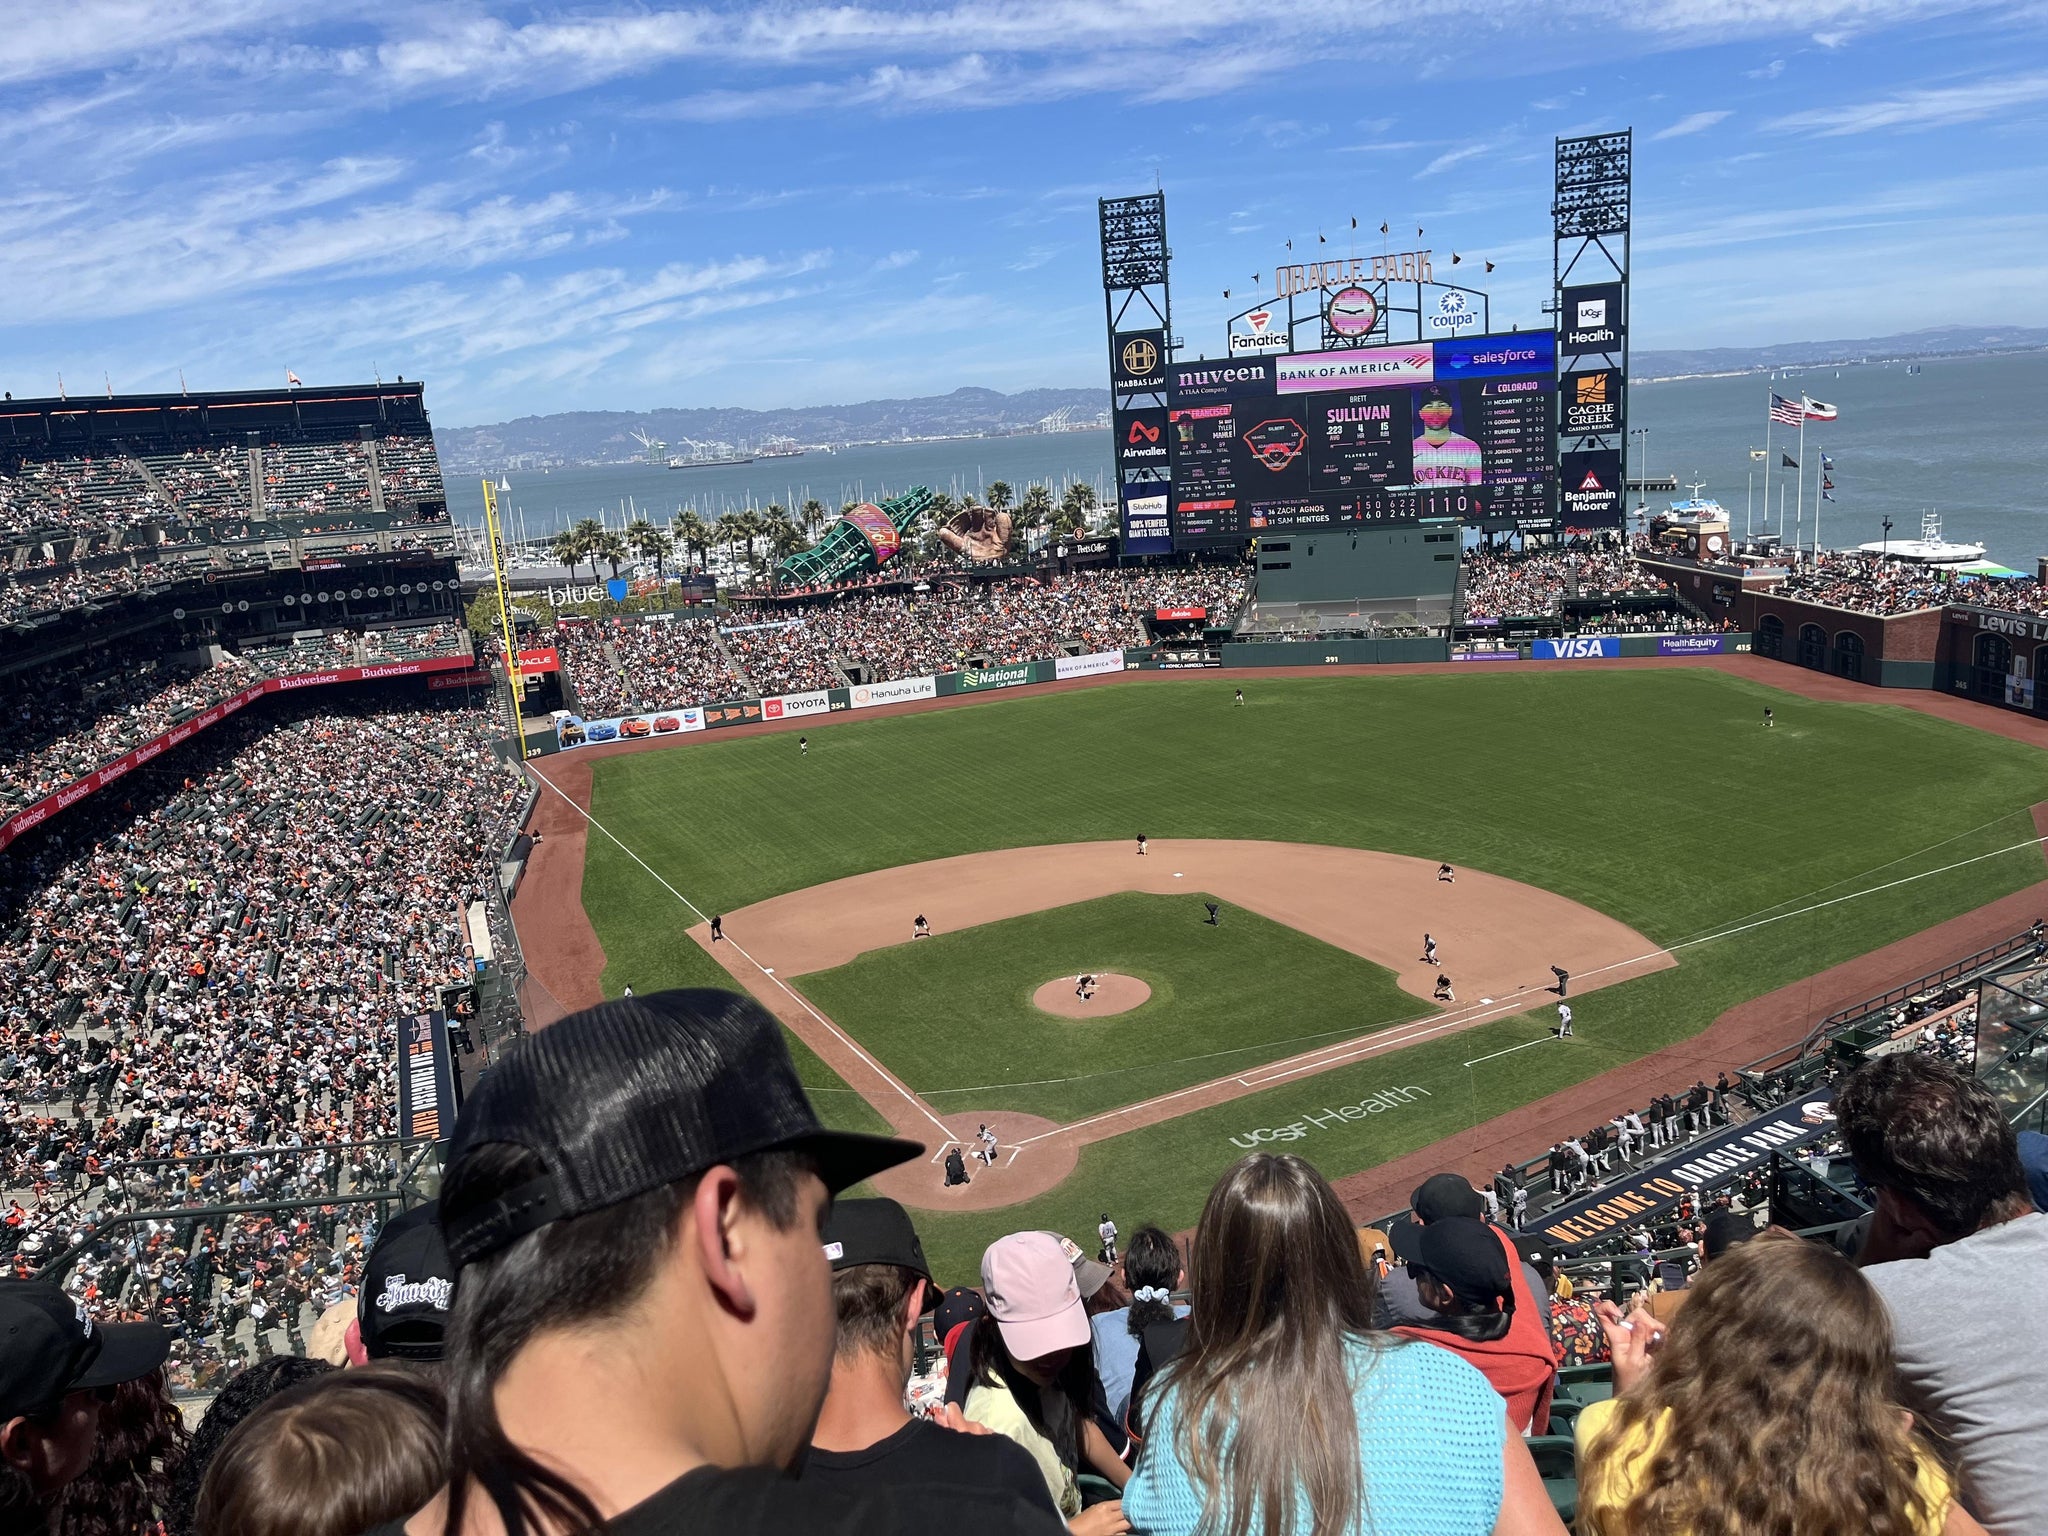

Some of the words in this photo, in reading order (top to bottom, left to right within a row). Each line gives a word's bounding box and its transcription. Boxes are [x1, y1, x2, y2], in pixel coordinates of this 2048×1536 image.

[1276, 259, 1363, 299] ORACLE
[1372, 250, 1433, 284] PARK
[1580, 308, 1603, 319] UCSF
[1433, 314, 1473, 328] coupa
[1232, 333, 1288, 349] Fanatics
[1569, 329, 1614, 344] Health
[1473, 349, 1536, 365] salesforce
[1178, 365, 1266, 387] nuveen
[1280, 369, 1315, 381] BANK
[1319, 367, 1335, 377] OF
[1339, 362, 1400, 375] AMERICA
[1118, 378, 1147, 388] HABBAS
[1148, 377, 1164, 386] LAW
[1497, 381, 1538, 392] COLORADO
[1201, 386, 1228, 394] Company
[1349, 395, 1367, 403] BRETT
[1327, 405, 1390, 423] SULLIVAN
[1567, 404, 1615, 416] CACHE
[1569, 414, 1613, 425] CREEK
[1326, 426, 1343, 435] .223
[1357, 424, 1364, 433] 4
[1380, 422, 1389, 431] 15
[1123, 446, 1167, 458] Airwallex
[1496, 476, 1527, 484] SULLIVAN
[1565, 489, 1616, 503] Benjamin
[1132, 501, 1162, 511] StubHub
[1277, 507, 1296, 515] ZACH
[1299, 505, 1325, 513] AGNOS
[1366, 501, 1371, 509] 5
[1375, 501, 1381, 509] 0
[1390, 500, 1395, 508] 6
[1410, 499, 1415, 507] 2
[1429, 498, 1435, 513] 1
[1444, 497, 1450, 513] 1
[1457, 496, 1467, 511] 0
[1572, 502, 1609, 512] Moore
[1296, 515, 1329, 523] HENTGES
[1366, 511, 1371, 519] 6
[1375, 510, 1381, 518] 0
[1390, 510, 1396, 518] 2
[1400, 509, 1405, 517] 4
[1410, 508, 1416, 516] 2
[1130, 520, 1144, 529] 100%
[1144, 519, 1168, 528] VERIFIED
[1128, 529, 1148, 538] GIANTS
[1148, 528, 1169, 537] TICKETS
[1091, 543, 1107, 552] Coffee
[547, 583, 604, 608] blue
[645, 614, 657, 622] FAN
[658, 612, 675, 621] ZONE
[1549, 640, 1603, 658] VISA
[1663, 638, 1718, 648] HealthEquity
[507, 656, 552, 668] RACLE
[361, 664, 420, 679] Budweiser
[978, 667, 1028, 684] National
[279, 673, 339, 690] Budweiser
[445, 674, 487, 685] Budweiser
[1007, 679, 1028, 687] Rental
[871, 685, 911, 699] Hanwha
[913, 684, 931, 694] Life
[786, 698, 826, 711] TOYOTA
[831, 701, 846, 710] 354
[527, 747, 541, 757] 339
[99, 762, 128, 785] Budweiser
[56, 783, 89, 809] Budweiser
[11, 808, 46, 836] Budweiser
[410, 1066, 438, 1111] FRANCISCO
[1228, 1121, 1308, 1148] UCSF
[1302, 1085, 1432, 1130] Health
[1544, 1189, 1657, 1244] WELCOME
[1641, 1176, 1686, 1198] TO
[1670, 1142, 1759, 1184] ORACLE
[1748, 1119, 1809, 1152] PARK
